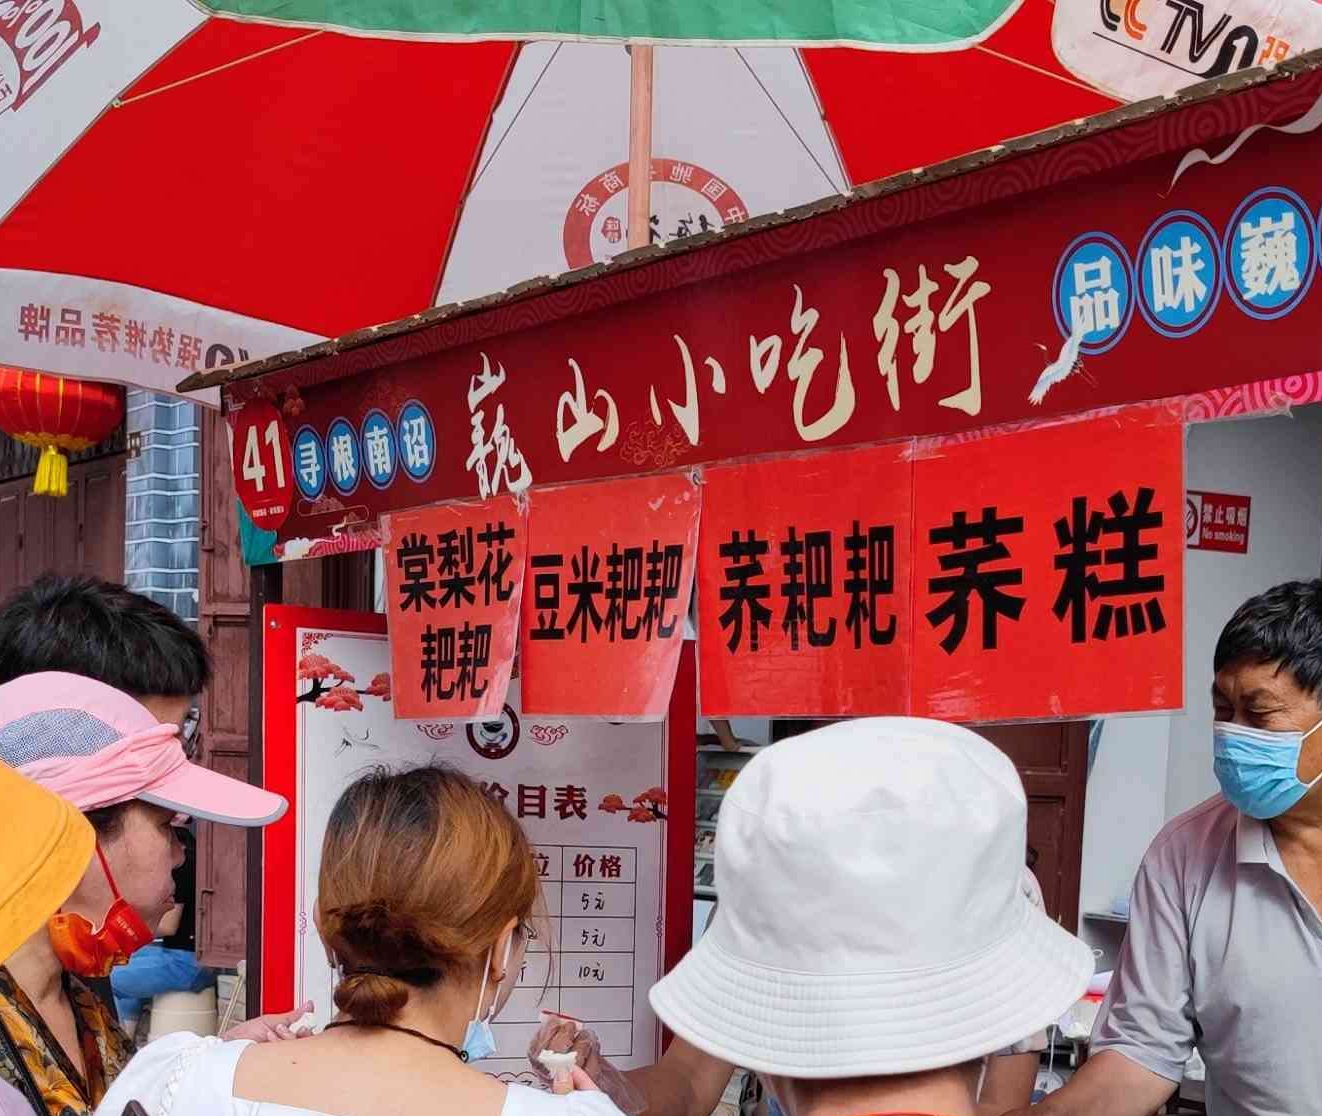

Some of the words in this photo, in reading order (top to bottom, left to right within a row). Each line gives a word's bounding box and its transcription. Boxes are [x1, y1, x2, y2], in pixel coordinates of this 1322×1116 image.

[466, 255, 992, 500] 巍山小吃街
[242, 420, 286, 493] 41
[297, 415, 432, 489] 寻根南诏
[396, 521, 515, 614] 棠梨花
[529, 541, 684, 645] 豆米粑粑
[718, 523, 897, 653] 荞粑粑
[927, 486, 1169, 654] 荞糕
[420, 620, 492, 704] 粑粑
[572, 852, 622, 879] 价格
[581, 891, 605, 911] 5元
[578, 962, 605, 982] 10元
[581, 929, 606, 947] 5元
